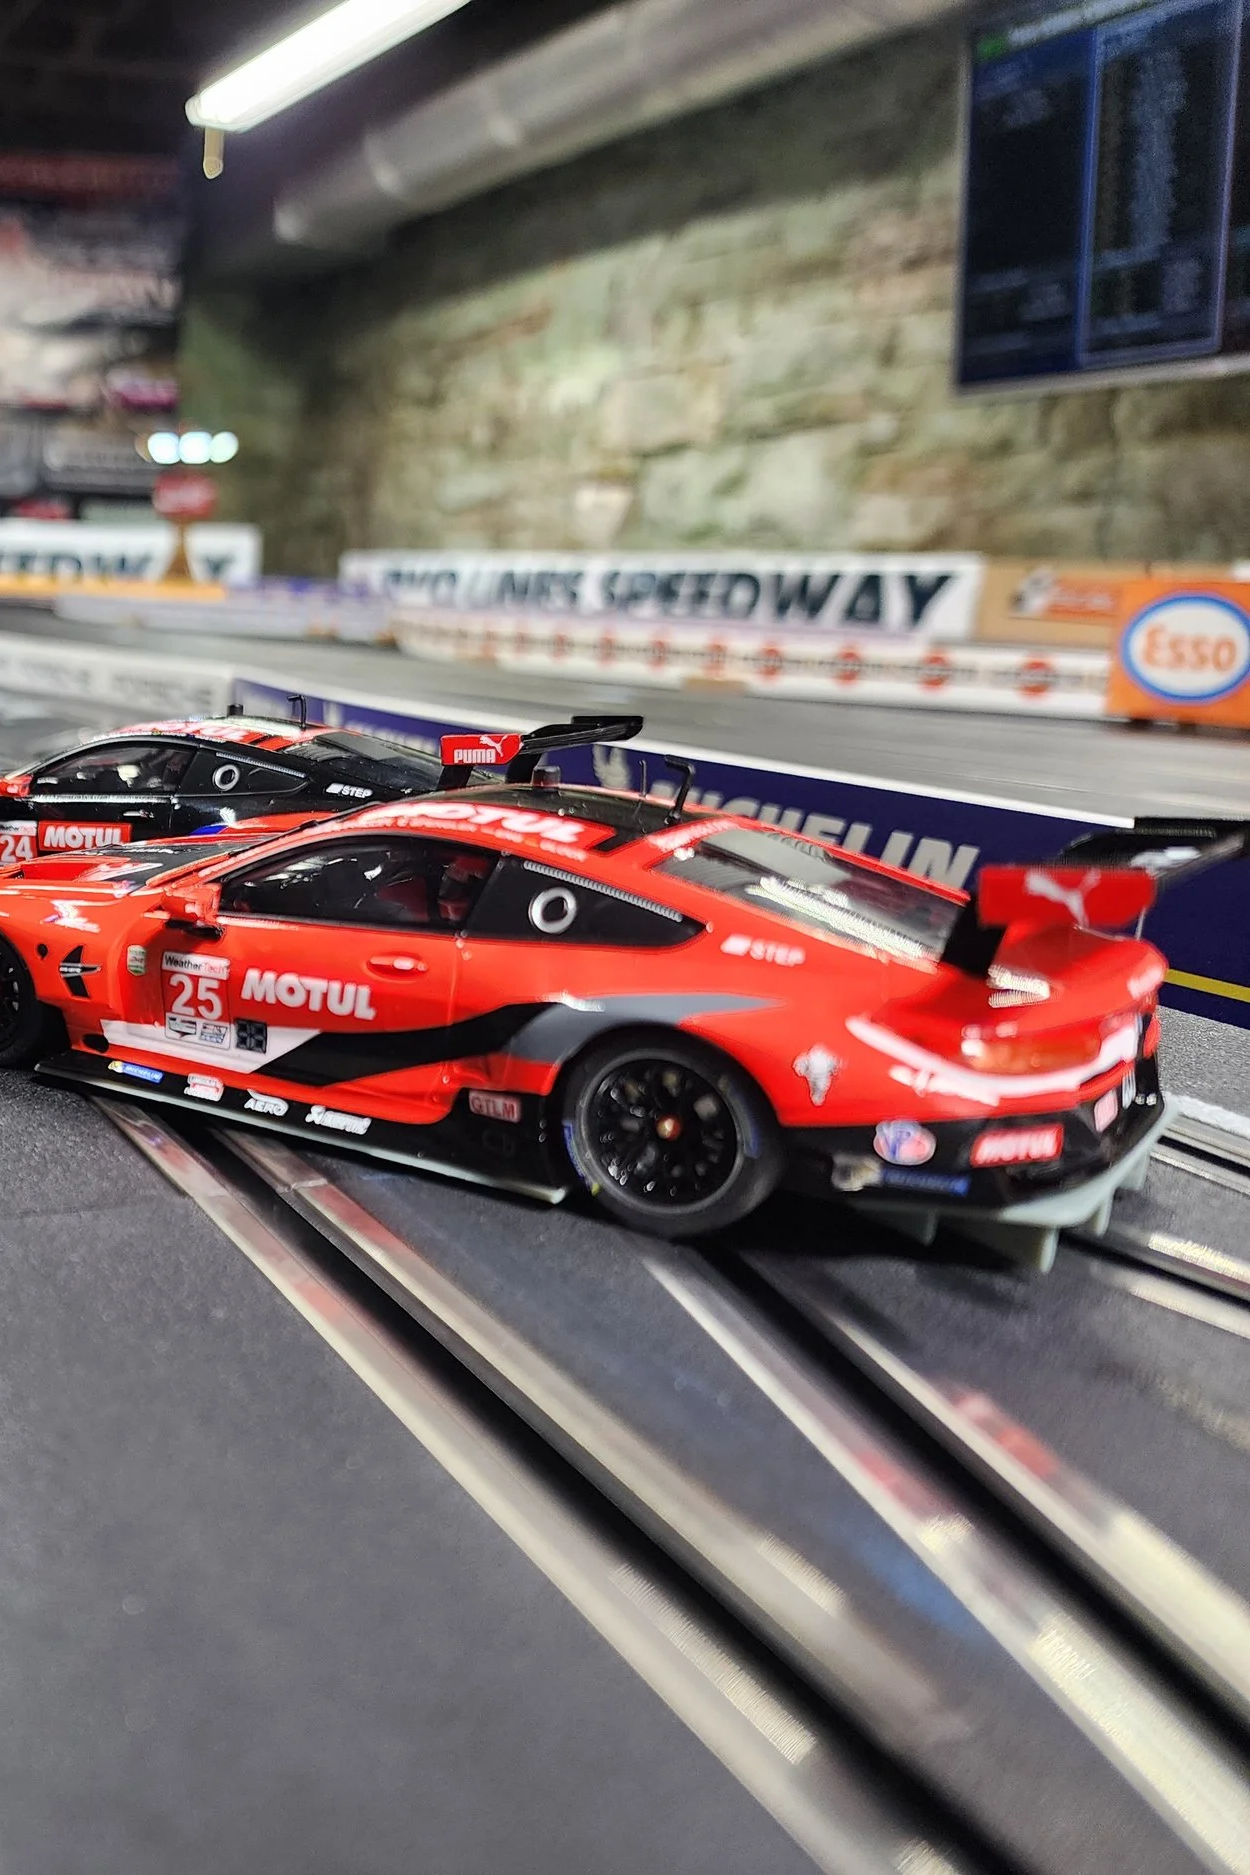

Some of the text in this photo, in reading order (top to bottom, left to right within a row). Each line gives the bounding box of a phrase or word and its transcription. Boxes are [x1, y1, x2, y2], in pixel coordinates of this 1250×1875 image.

[600, 570, 962, 630] SPEEDWAY
[453, 748, 497, 764] PUMA
[341, 784, 374, 799] STEP
[0, 834, 35, 863] 24
[43, 825, 124, 849] MOTUL
[749, 937, 806, 968] STEP
[169, 973, 222, 1021] 25
[240, 967, 377, 1021] MOTUL
[469, 1094, 517, 1120] GTLM
